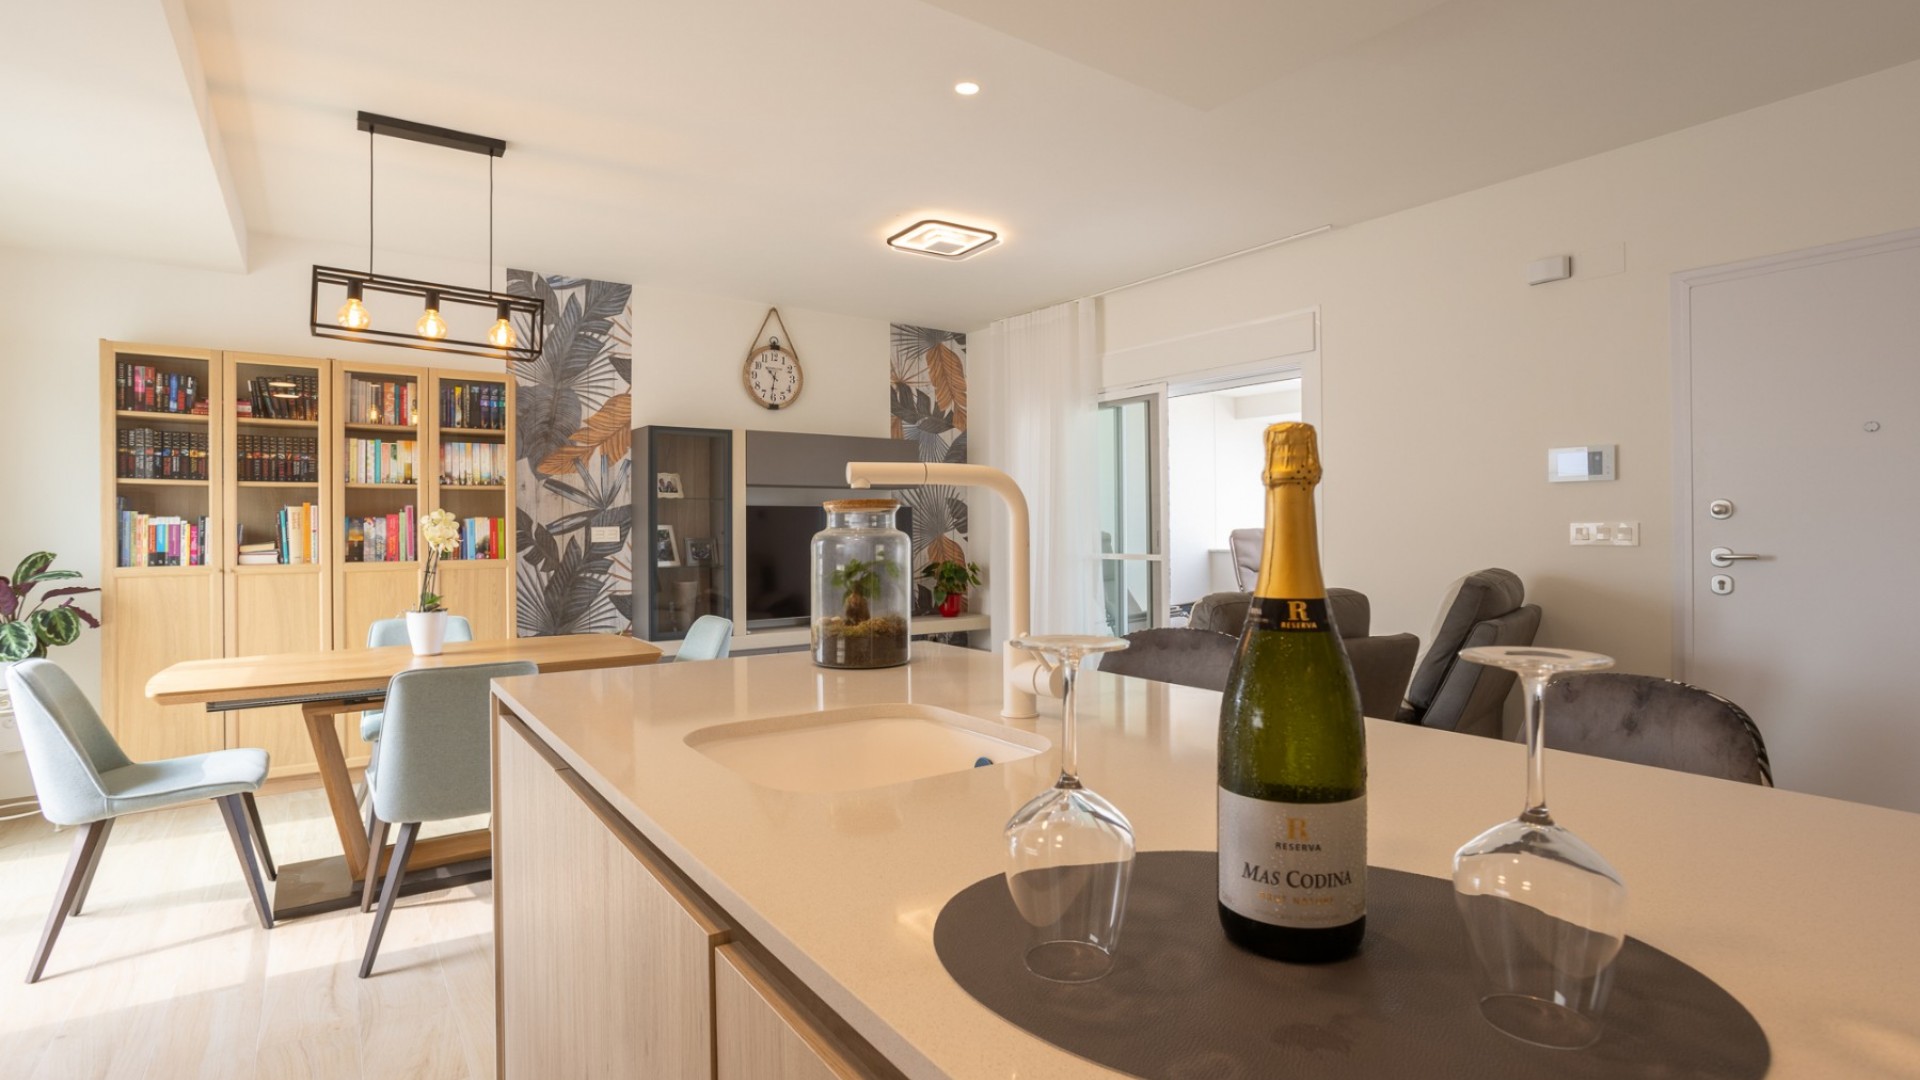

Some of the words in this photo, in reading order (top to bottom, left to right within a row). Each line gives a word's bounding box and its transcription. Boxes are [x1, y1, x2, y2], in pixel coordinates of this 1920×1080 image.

[762, 353, 768, 363] 11
[771, 352, 778, 362] 12
[782, 356, 786, 366] 1
[754, 361, 762, 370] 10
[787, 365, 793, 374] 2
[752, 370, 758, 380] 9
[789, 375, 796, 384] 3
[755, 381, 761, 390] 8
[786, 385, 792, 394] 4
[762, 389, 766, 398] 7
[780, 391, 786, 400] 5
[1287, 601, 1310, 621] R
[1280, 621, 1318, 630] RESERVA
[1286, 817, 1309, 841] R
[1275, 842, 1322, 852] RESERVA
